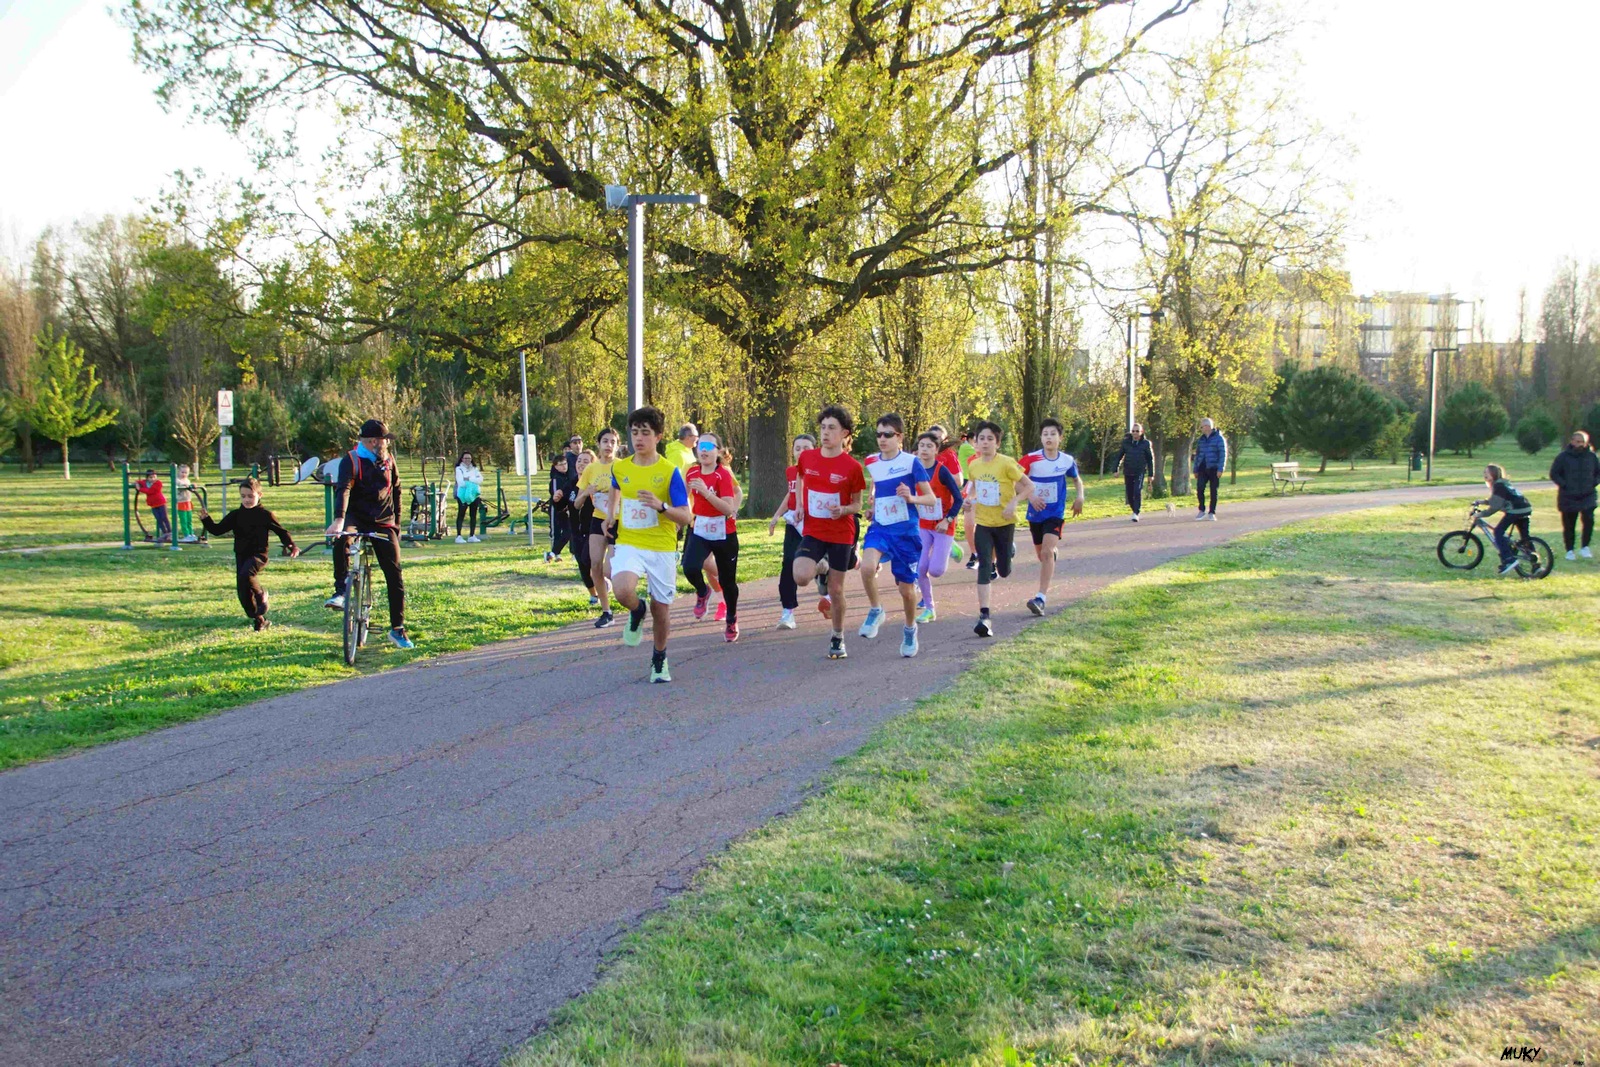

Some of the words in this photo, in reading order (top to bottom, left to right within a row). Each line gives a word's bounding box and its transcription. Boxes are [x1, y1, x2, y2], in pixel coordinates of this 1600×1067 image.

[982, 488, 988, 498] 2
[1038, 488, 1050, 498] 23
[631, 508, 647, 519] 26
[883, 504, 897, 516] 14
[704, 523, 717, 533] 15
